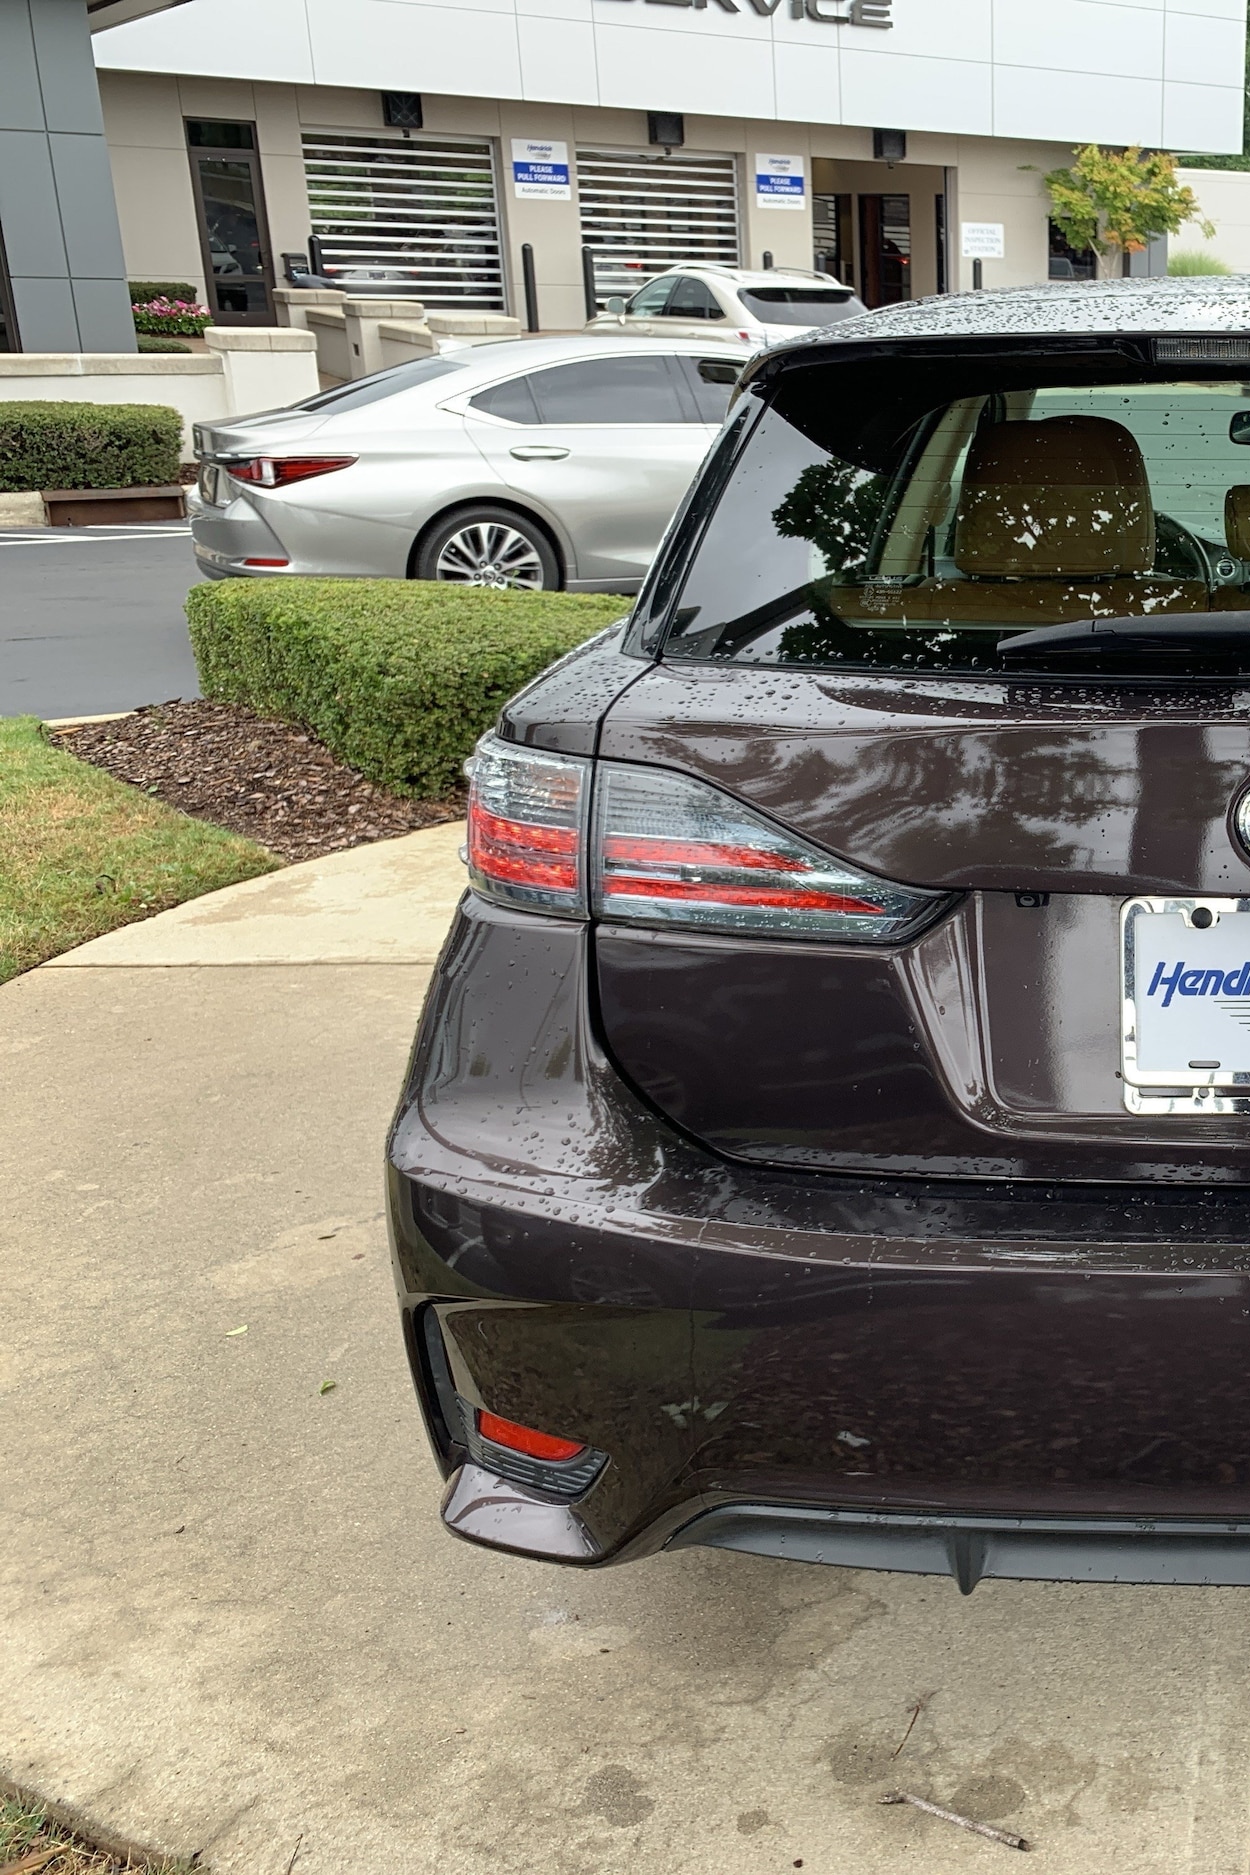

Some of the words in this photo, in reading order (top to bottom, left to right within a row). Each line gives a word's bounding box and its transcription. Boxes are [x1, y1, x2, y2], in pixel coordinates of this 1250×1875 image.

[596, 0, 893, 28] VICE
[529, 165, 553, 173] PLEASE
[517, 173, 533, 181] PULL
[534, 174, 566, 182] FORWARD
[770, 177, 791, 185] PLEASE
